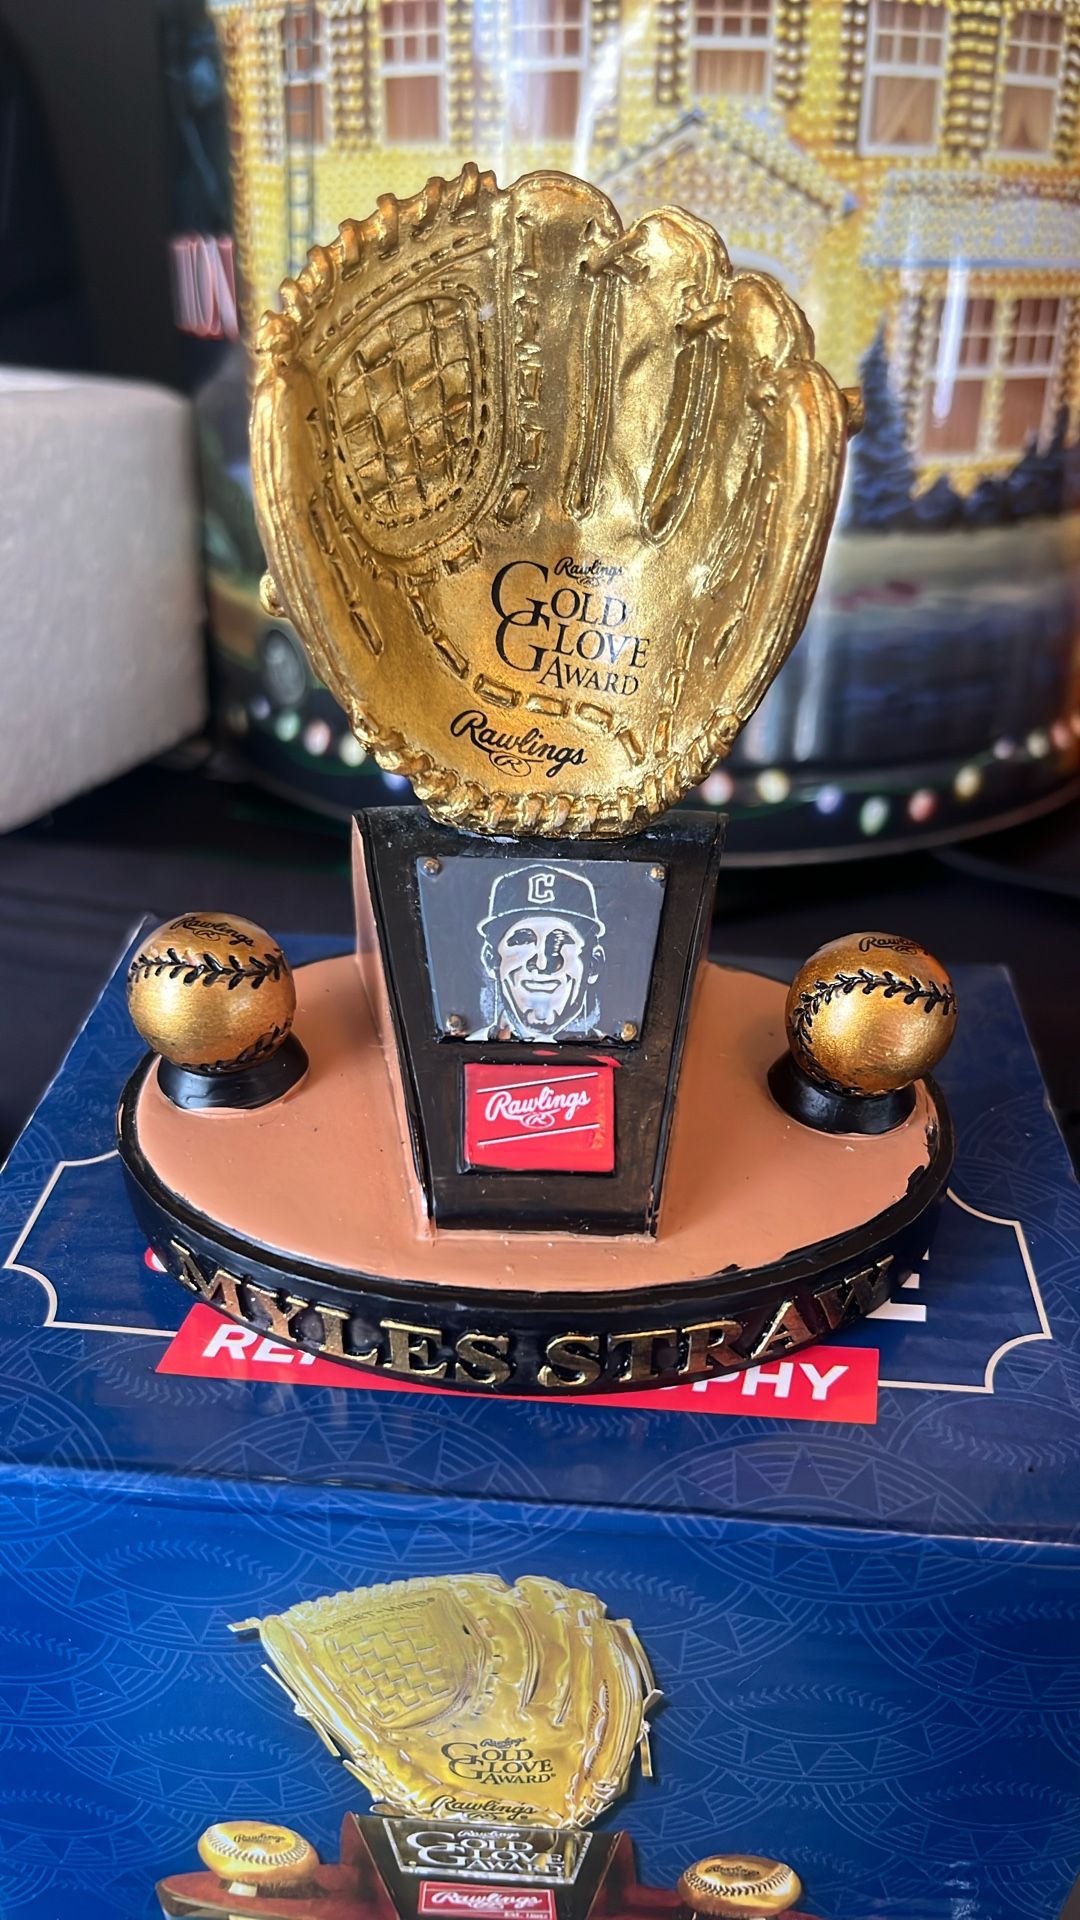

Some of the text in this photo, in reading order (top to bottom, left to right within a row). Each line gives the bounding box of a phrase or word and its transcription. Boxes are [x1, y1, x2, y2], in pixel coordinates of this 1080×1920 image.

[554, 557, 623, 582] Rawlings
[491, 560, 629, 628] GOLD
[495, 611, 651, 673] GLOVE
[537, 656, 640, 697] AWARD
[450, 709, 588, 778] Rawlings
[527, 873, 556, 905] C
[169, 917, 256, 947] Rawlings
[485, 1086, 592, 1121] Rawlings
[171, 1239, 511, 1386] MYLES
[537, 1253, 896, 1388] STRAW
[441, 1742, 534, 1765] GOLD
[448, 1758, 554, 1780] GLOVE
[430, 1794, 539, 1820] Rawlings
[406, 1831, 534, 1852] GOLD
[418, 1845, 565, 1866] GLOVE
[431, 1891, 543, 1909] Rawlings
